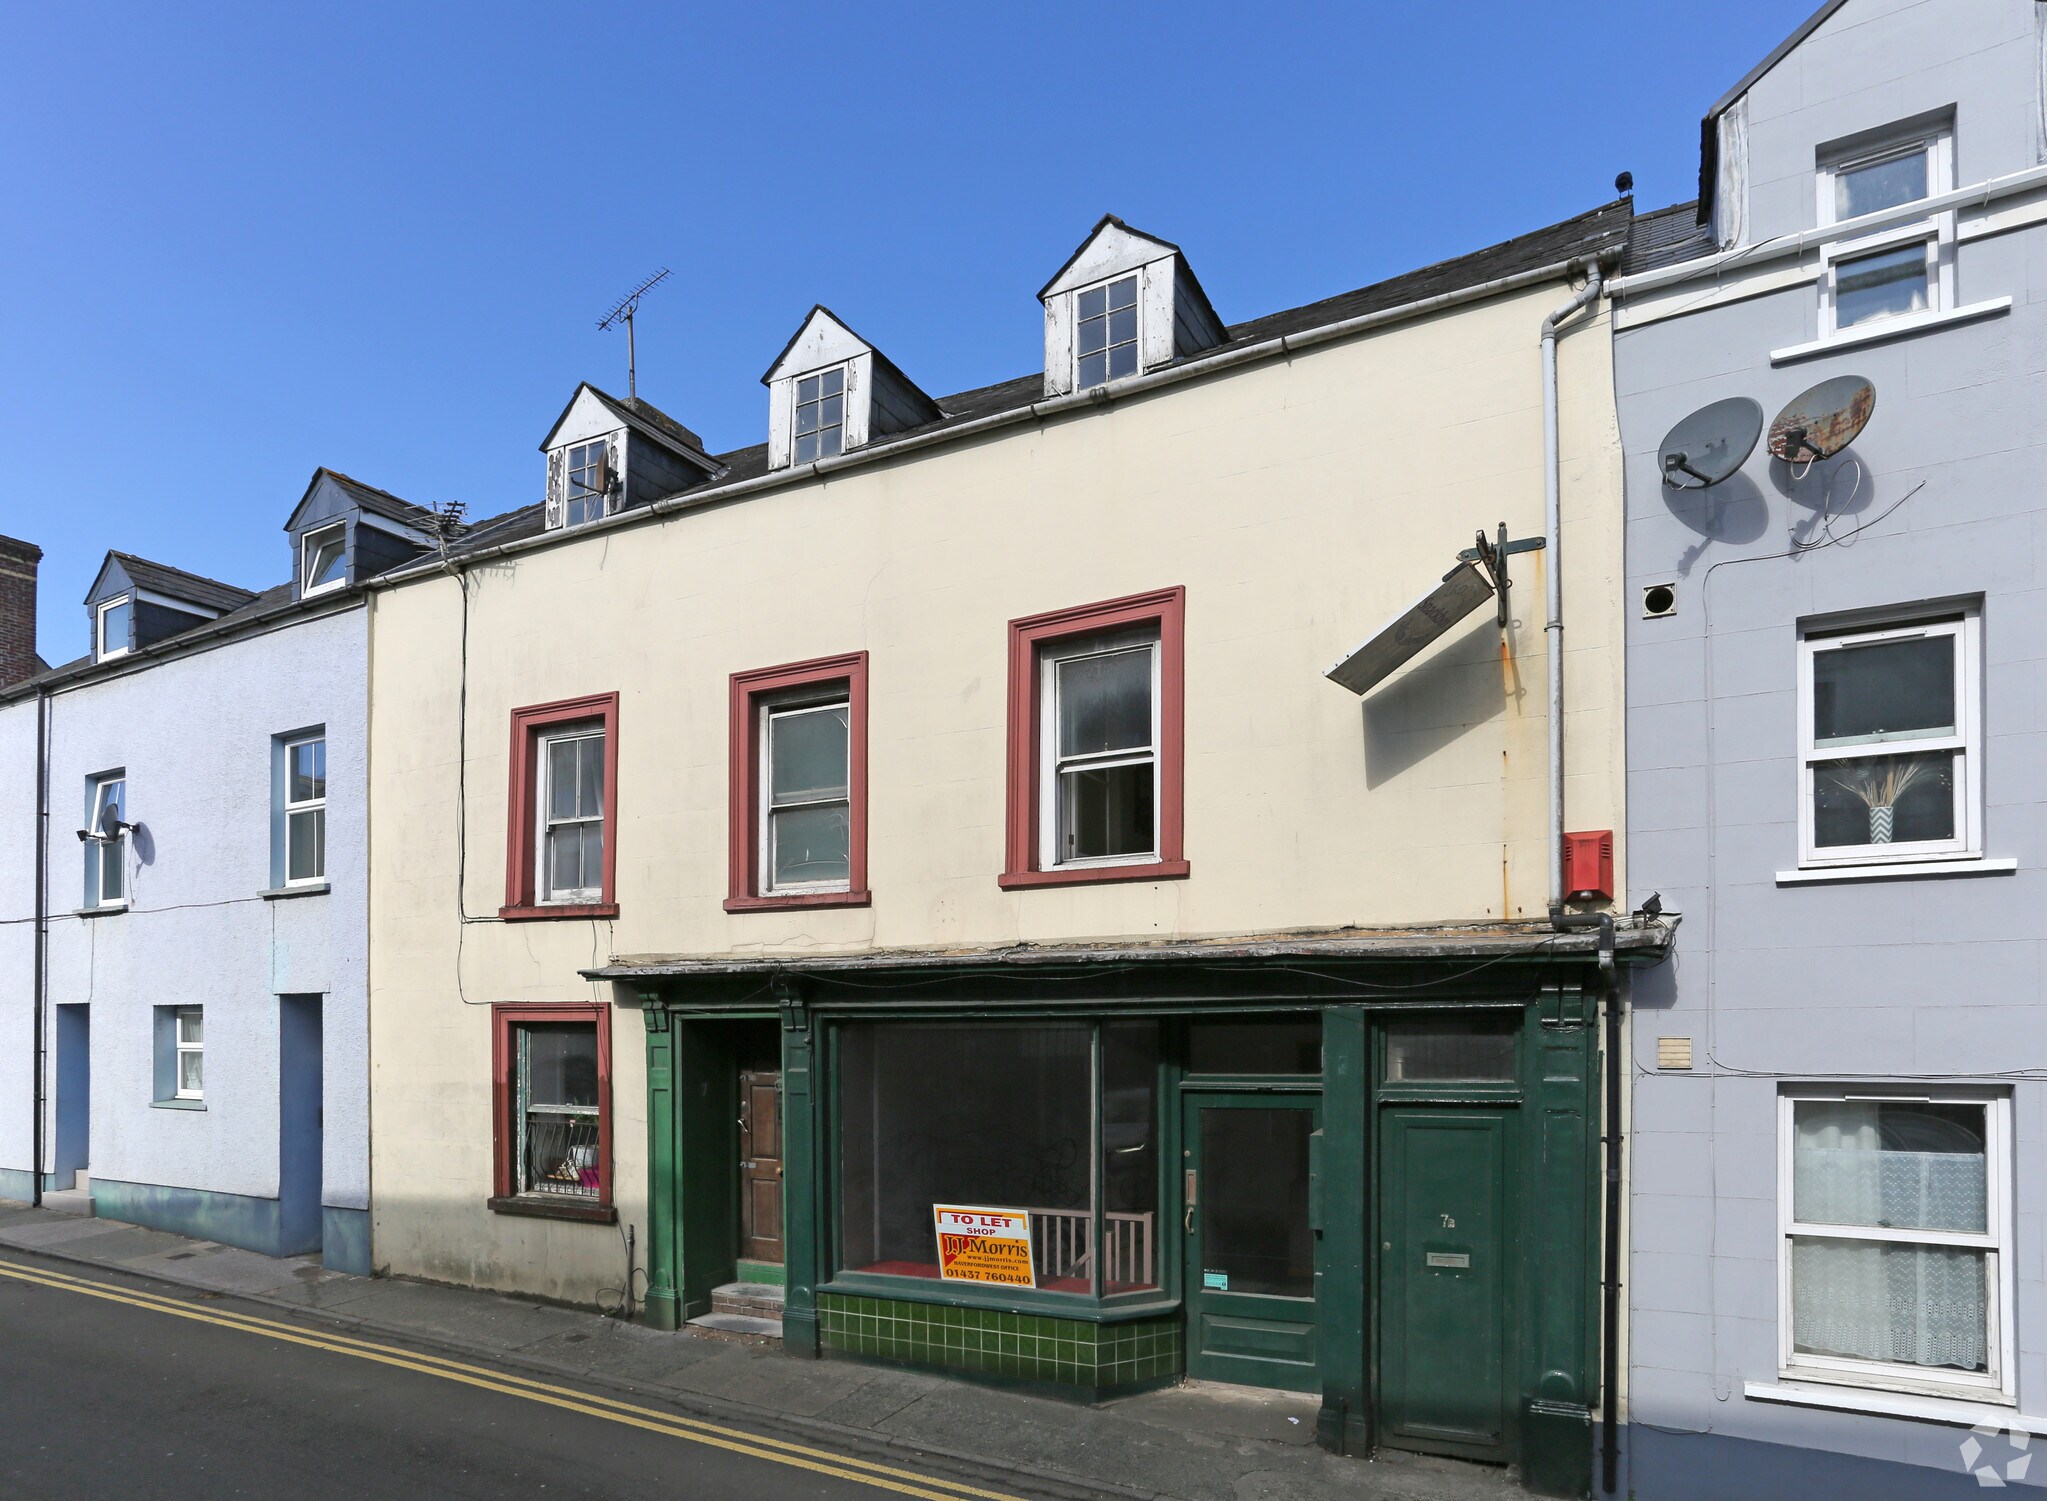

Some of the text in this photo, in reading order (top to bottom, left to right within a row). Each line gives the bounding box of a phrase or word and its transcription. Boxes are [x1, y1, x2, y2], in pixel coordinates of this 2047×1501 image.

[951, 1215, 1012, 1228] TO LET
[966, 1227, 996, 1235] SHOP
[969, 1238, 1028, 1257] Morris
[967, 1255, 1028, 1265] www.jjmorris.com
[946, 1268, 1030, 1284] 01437 760440
